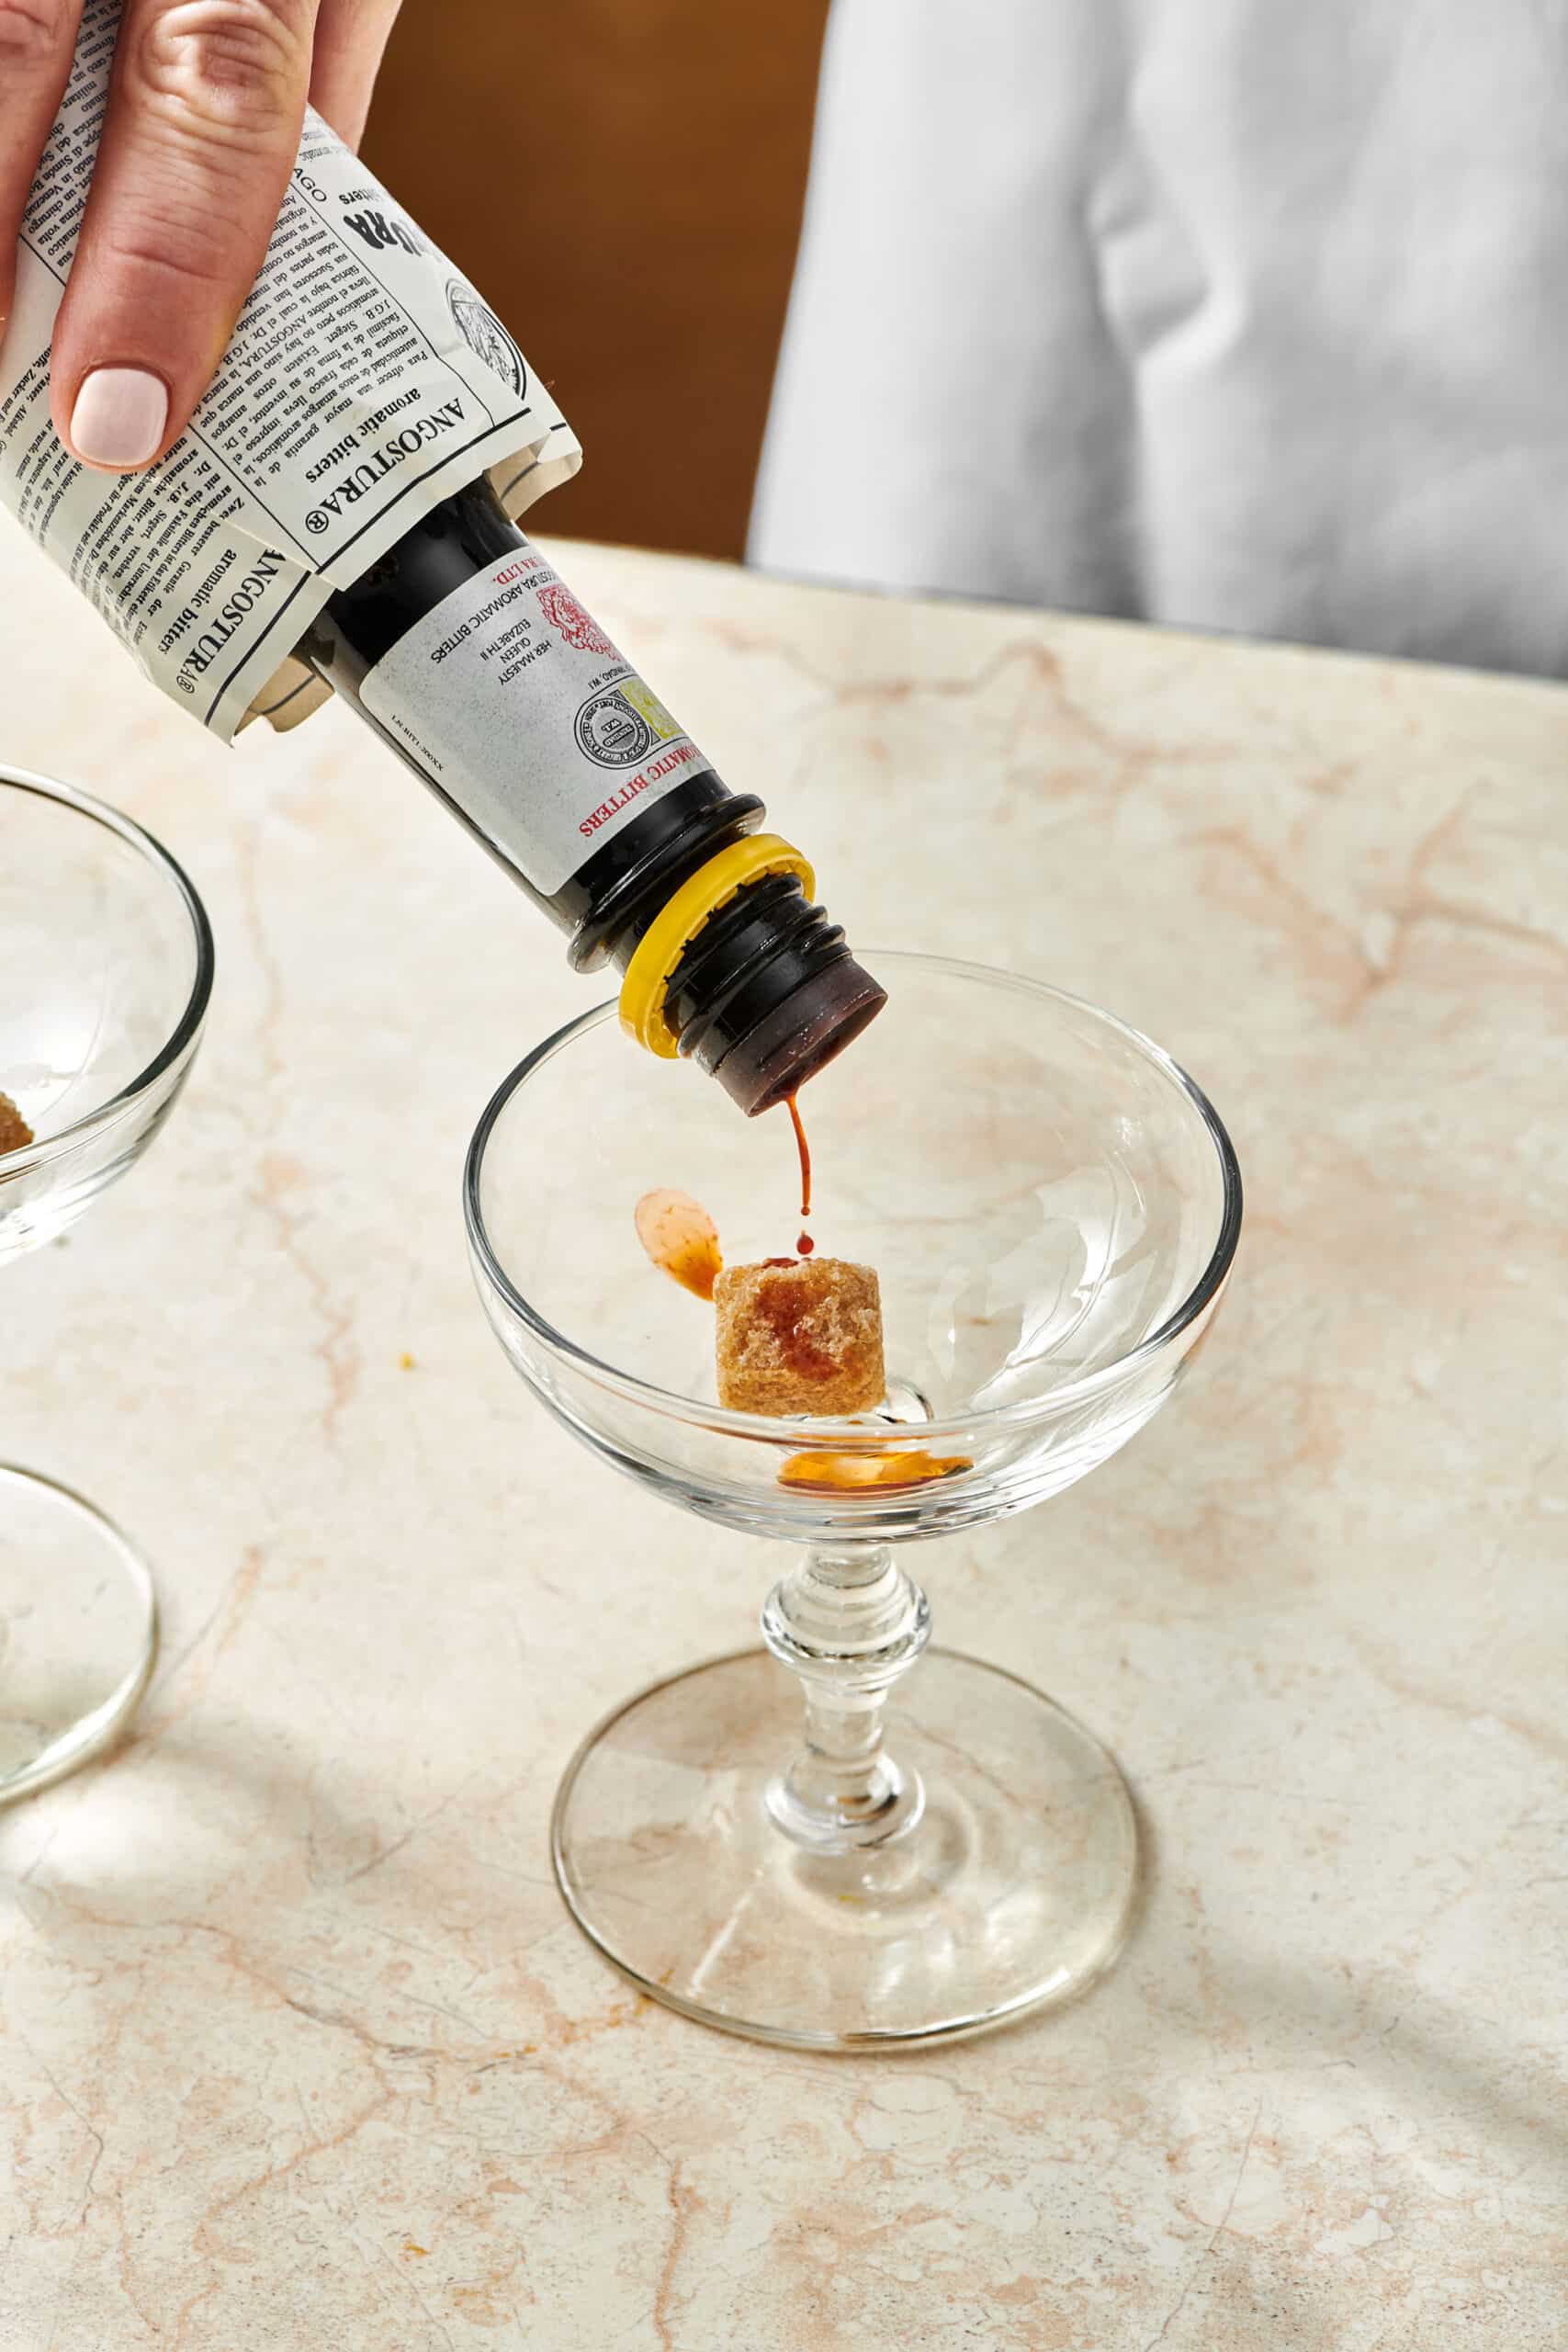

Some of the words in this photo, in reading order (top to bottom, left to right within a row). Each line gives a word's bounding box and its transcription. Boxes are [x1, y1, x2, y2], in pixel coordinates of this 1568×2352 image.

[72, 107, 108, 137] merica
[54, 135, 72, 153] del
[71, 145, 84, 159] di
[40, 153, 73, 182] Simón
[60, 172, 74, 185] in
[292, 167, 327, 202] AGO
[62, 188, 77, 201] un
[24, 198, 64, 235] chirurgo
[58, 198, 89, 225] prima
[309, 215, 317, 225] y
[36, 223, 62, 246] volta
[297, 221, 310, 232] su
[265, 228, 298, 253] nombre
[293, 229, 327, 252] amargos
[315, 241, 338, 257] todas
[56, 250, 73, 267] sua
[282, 248, 296, 259] no
[288, 251, 315, 274] partes
[333, 252, 347, 264] sus
[272, 271, 288, 287] del
[291, 261, 333, 290] Sucesores
[330, 264, 359, 285] fábrica
[347, 275, 370, 291] lleva
[272, 288, 293, 303] han
[298, 293, 311, 304] la
[310, 280, 332, 297] bajo
[337, 288, 349, 300] el
[277, 301, 299, 321] cual
[306, 293, 339, 318] nombre
[335, 287, 379, 318] aromáticos
[364, 298, 390, 321] J.G.B.
[234, 302, 272, 333] vendido
[265, 317, 277, 330] el
[314, 311, 335, 330] pero
[237, 313, 307, 368] ANGOSTURA,
[249, 325, 267, 341] Dr.
[301, 327, 315, 339] no
[323, 319, 358, 345] Siegert.
[352, 333, 366, 345] de
[374, 323, 409, 349] etiqueta
[218, 339, 250, 367] J.G.B.
[283, 336, 304, 354] hay
[341, 341, 354, 352] la
[360, 346, 373, 358] de
[369, 336, 418, 373] autenticidad
[263, 351, 284, 370] sino
[282, 345, 320, 374] Existen
[316, 348, 342, 368] firma
[338, 356, 359, 371] cada
[406, 349, 428, 367] Para
[227, 368, 242, 380] la
[243, 368, 263, 386] una
[302, 366, 316, 379] de
[308, 369, 338, 395] frasco
[337, 373, 360, 391] estos
[358, 367, 371, 378] de
[376, 365, 405, 386] ofrecer
[11, 368, 37, 399] Zucker
[200, 378, 229, 404] marca
[252, 377, 277, 401] otros
[288, 378, 301, 390] su
[355, 382, 373, 396] una
[0, 396, 15, 415] und
[216, 385, 244, 412] marca
[247, 388, 289, 424] inventor,
[282, 394, 308, 417] lleva
[300, 388, 338, 421] amargos
[198, 410, 218, 428] que
[322, 396, 353, 424] mayor
[356, 387, 422, 438] aromatic
[209, 403, 247, 439] amargos
[237, 424, 249, 438] el
[220, 435, 240, 451] Dr.
[244, 416, 281, 452] impreso
[251, 419, 302, 465] aromáticos,
[162, 436, 188, 463] unter
[231, 452, 243, 466] el
[304, 434, 361, 484] bitters
[51, 450, 70, 477] arauf
[193, 459, 211, 477] Dr.
[242, 464, 255, 476] la
[267, 460, 281, 475] de
[60, 468, 78, 490] keine
[116, 465, 139, 492] olger
[132, 460, 164, 495] welchem
[203, 472, 221, 492] mit
[253, 475, 267, 488] la
[107, 489, 122, 504] ihr
[87, 501, 113, 534] Produkt
[95, 493, 139, 550] Markenzeichen
[139, 508, 168, 540] Siegert,
[155, 508, 188, 548] Faksimile
[118, 524, 135, 544] aber
[170, 527, 196, 556] Bitters
[190, 519, 221, 557] besserer
[107, 544, 121, 560] nur
[111, 545, 141, 580] versehen.
[145, 547, 161, 562] der
[164, 552, 177, 566] ist
[154, 562, 169, 578] das
[162, 560, 192, 594] Garantie
[189, 548, 238, 608] aromatic
[491, 562, 524, 586] LTD.
[134, 574, 161, 605] Etikett
[146, 597, 163, 617] der
[468, 582, 523, 629] AROMATIC
[156, 606, 198, 655] bitters
[485, 617, 531, 656] ELIZABETH
[429, 623, 472, 664] BITTERS
[499, 637, 531, 664] QUEEN
[533, 639, 552, 656] HER
[479, 650, 489, 662] II
[497, 650, 536, 685] MAJESTY
[578, 774, 649, 838] BITTERS
